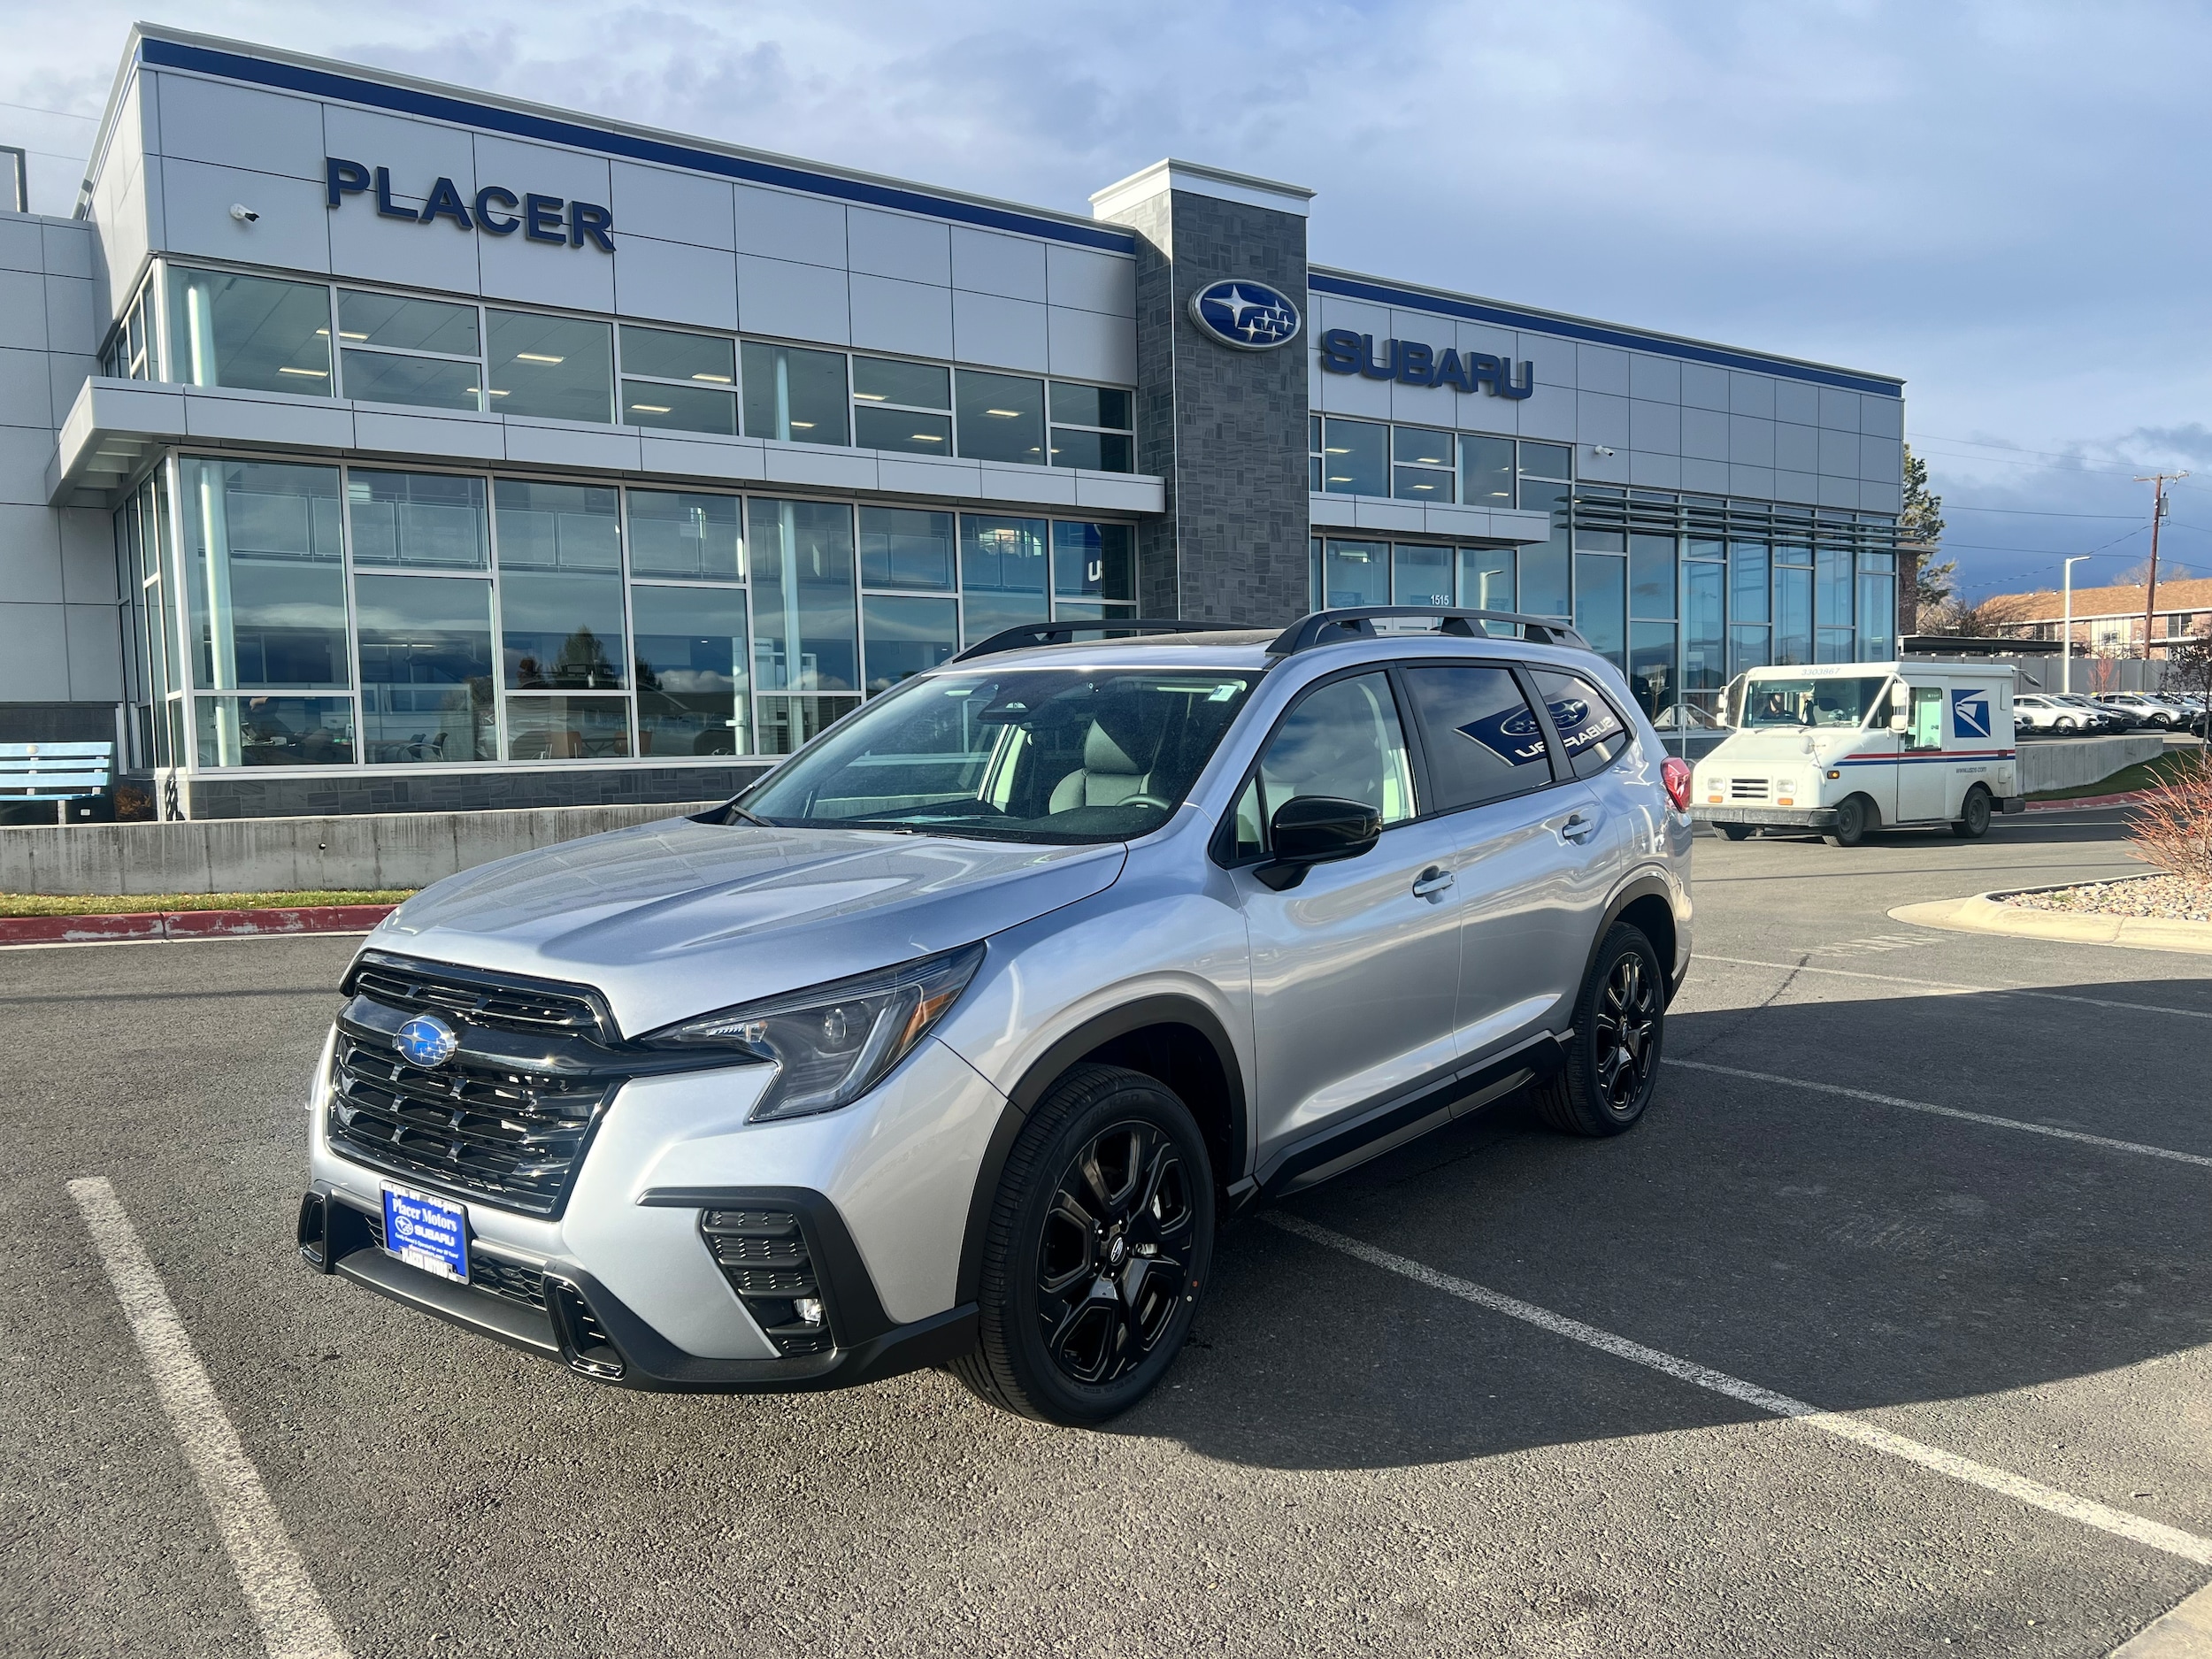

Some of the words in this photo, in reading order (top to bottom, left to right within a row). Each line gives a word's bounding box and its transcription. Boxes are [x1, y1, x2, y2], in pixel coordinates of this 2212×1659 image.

[325, 156, 617, 253] PLACER
[1321, 328, 1533, 400] SUBARU
[1430, 595, 1449, 605] 1515
[1801, 667, 1840, 676] 3303867
[392, 1197, 421, 1220] Placer
[422, 1208, 457, 1233] Motors
[414, 1225, 455, 1247] SUBARU
